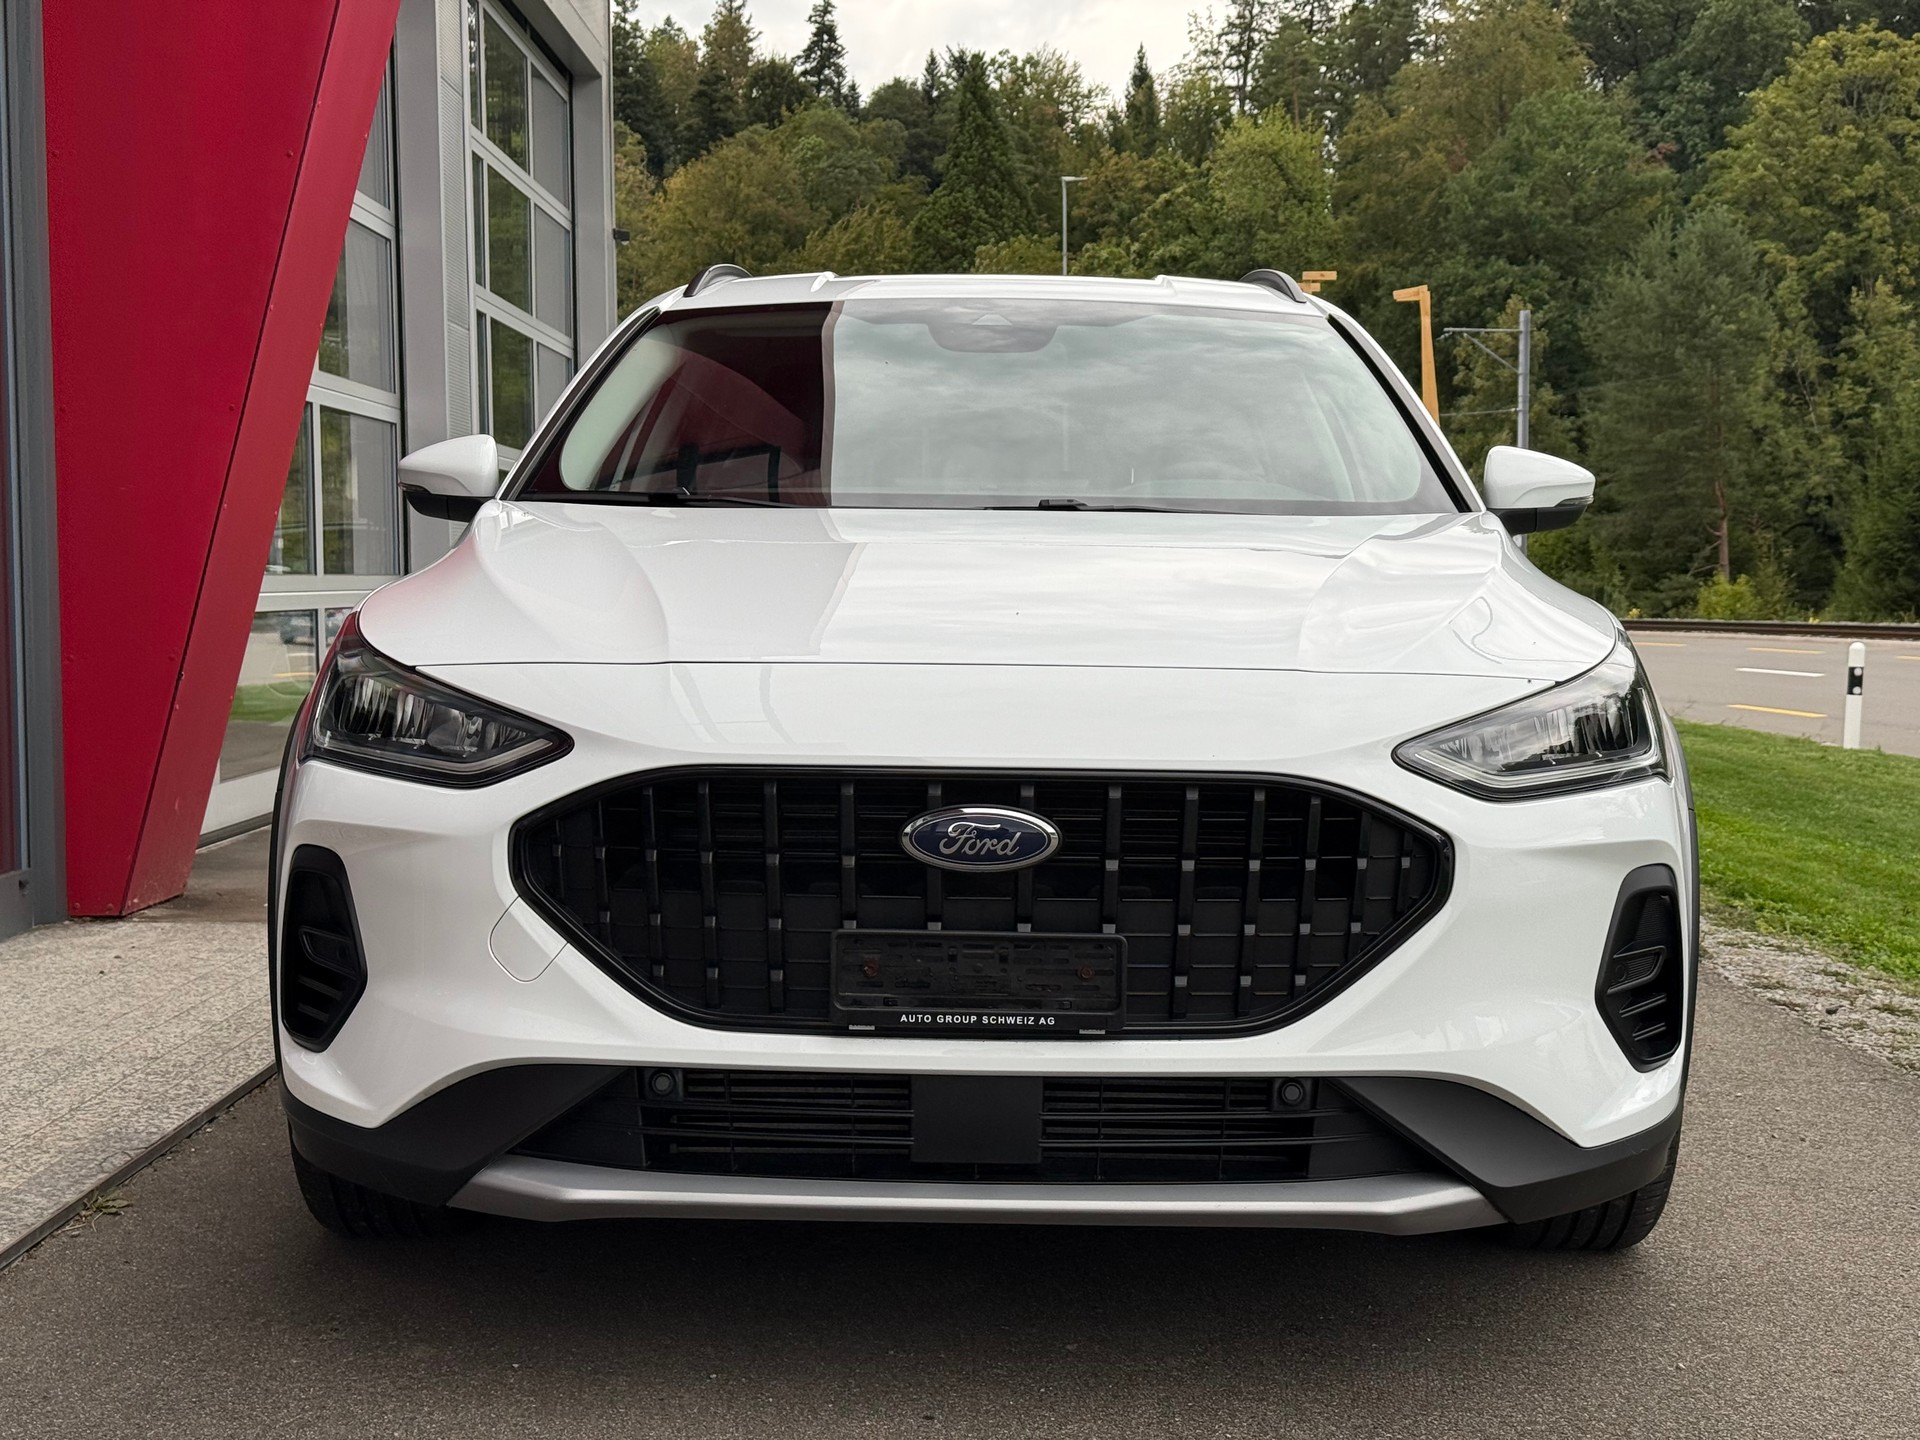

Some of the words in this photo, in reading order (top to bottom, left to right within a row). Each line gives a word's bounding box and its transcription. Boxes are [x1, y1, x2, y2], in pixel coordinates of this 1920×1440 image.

[938, 821, 1022, 856] Ford
[900, 1014, 932, 1023] AUTO
[936, 1014, 977, 1024] GROUP
[981, 1015, 1035, 1025] SCHWEIZ
[1038, 1016, 1055, 1026] AG
